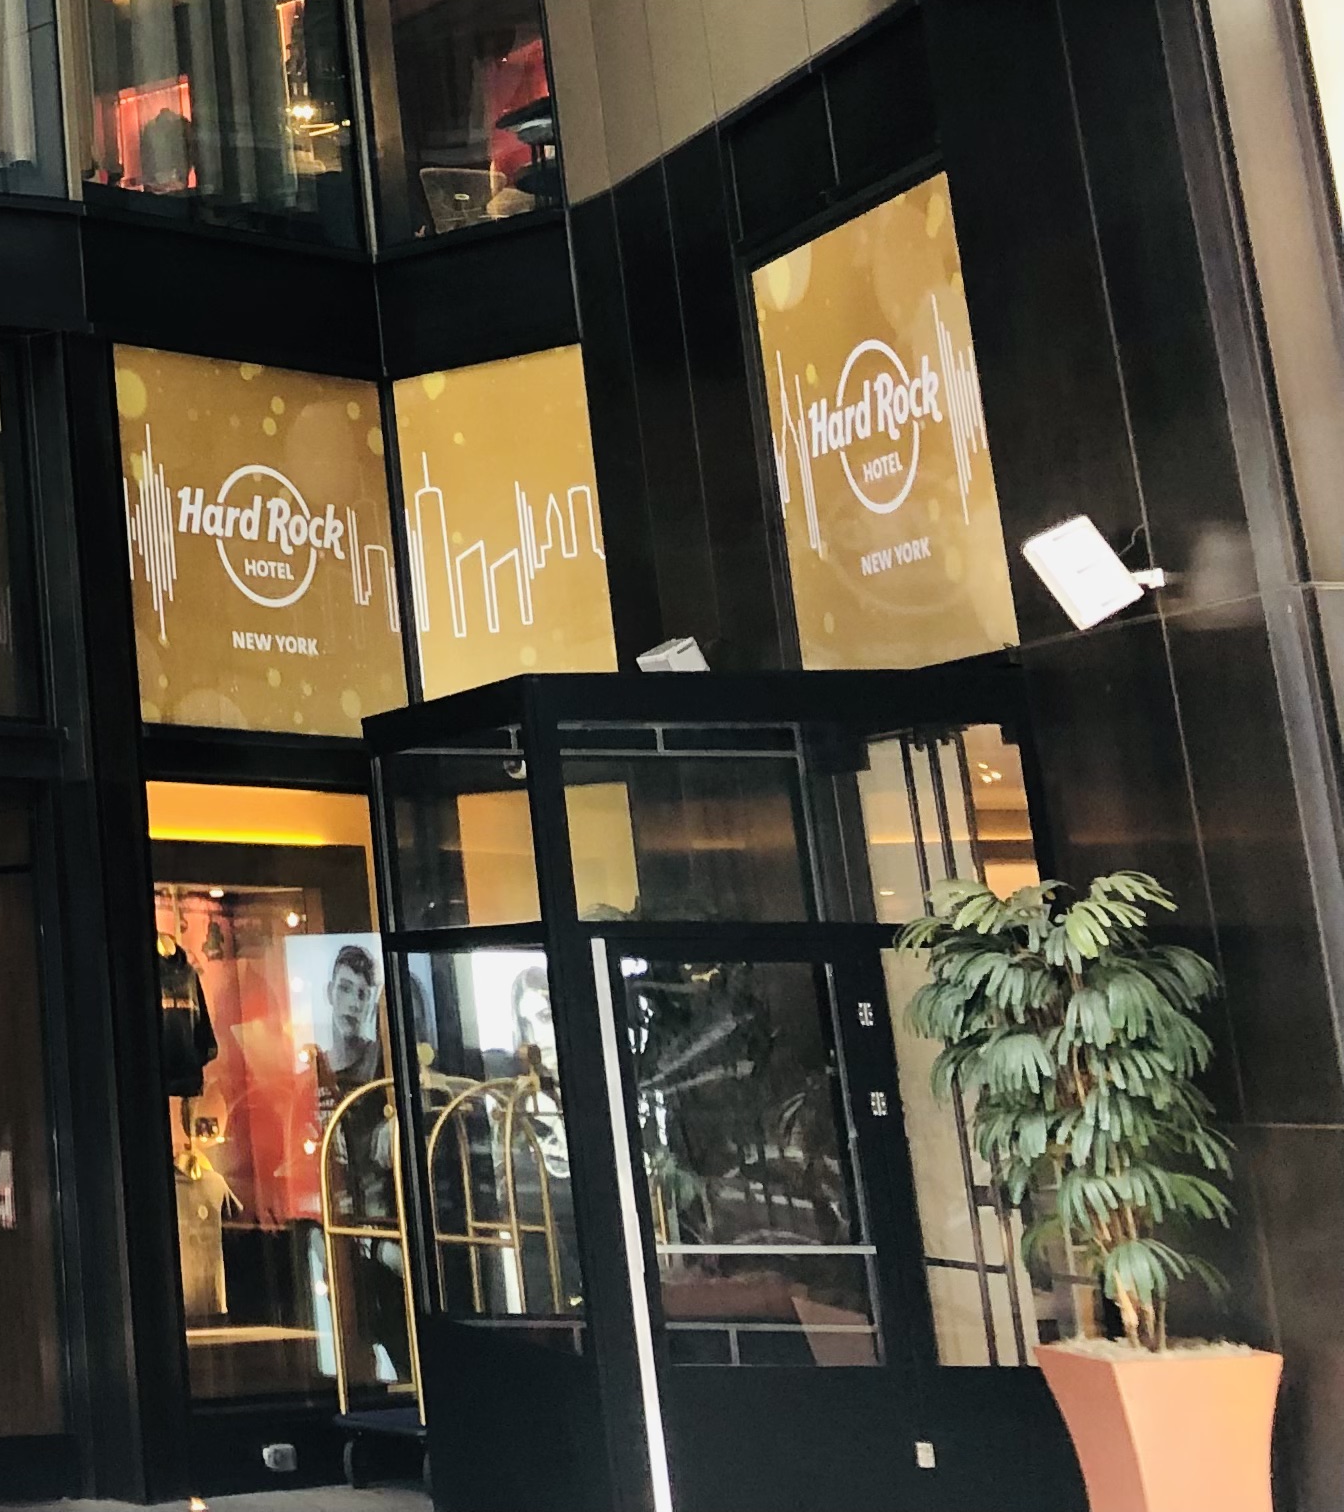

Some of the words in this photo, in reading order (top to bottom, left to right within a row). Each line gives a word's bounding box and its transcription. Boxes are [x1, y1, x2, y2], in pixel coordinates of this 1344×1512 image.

[808, 379, 872, 458] Hard
[873, 354, 943, 441] Rock
[863, 451, 903, 483] HOTEL
[177, 486, 262, 541] Hard
[266, 503, 345, 560] Rock
[244, 558, 295, 580] HOTEL
[861, 549, 893, 576] NEW
[895, 537, 932, 565] YORK
[232, 630, 272, 651] NEW
[274, 634, 319, 656] YORK
